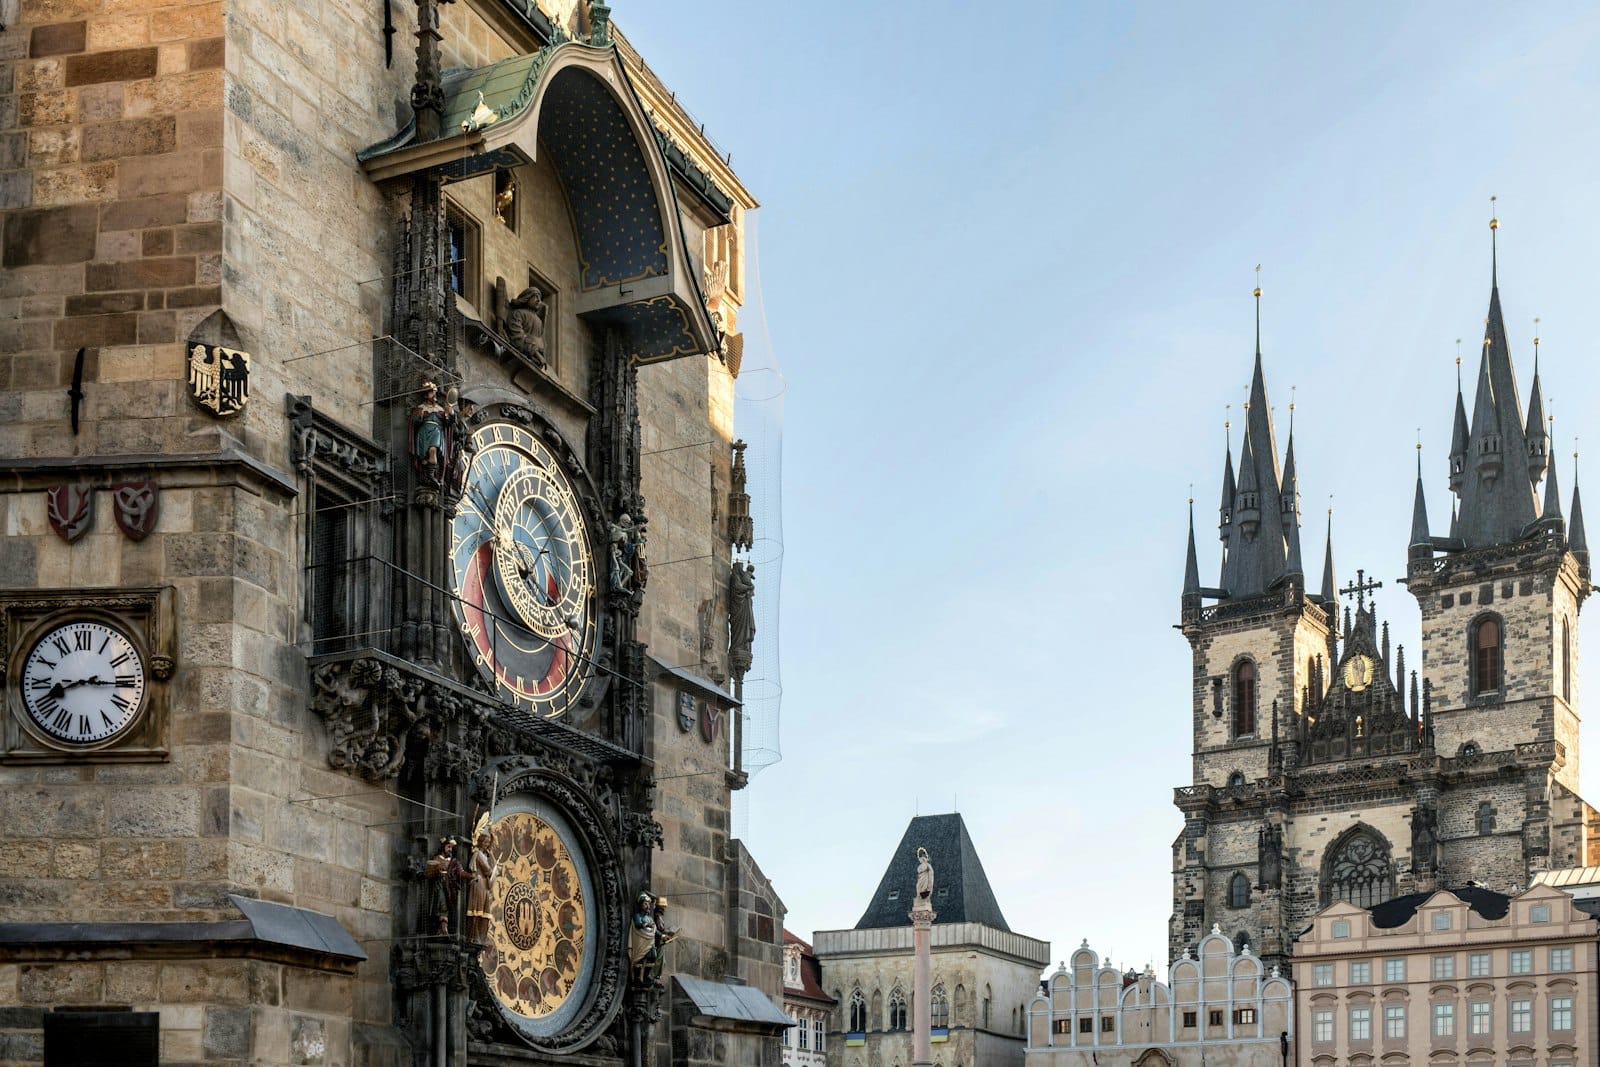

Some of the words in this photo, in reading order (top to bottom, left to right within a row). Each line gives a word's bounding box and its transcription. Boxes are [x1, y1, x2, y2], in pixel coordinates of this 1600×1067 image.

[53, 636, 71, 658] XI
[74, 630, 92, 652] XII
[98, 636, 110, 654] I
[36, 656, 56, 670] X
[110, 653, 130, 668] II
[32, 677, 51, 689] IX
[52, 709, 72, 732] VII
[79, 715, 92, 734] VI
[100, 710, 113, 728] V
